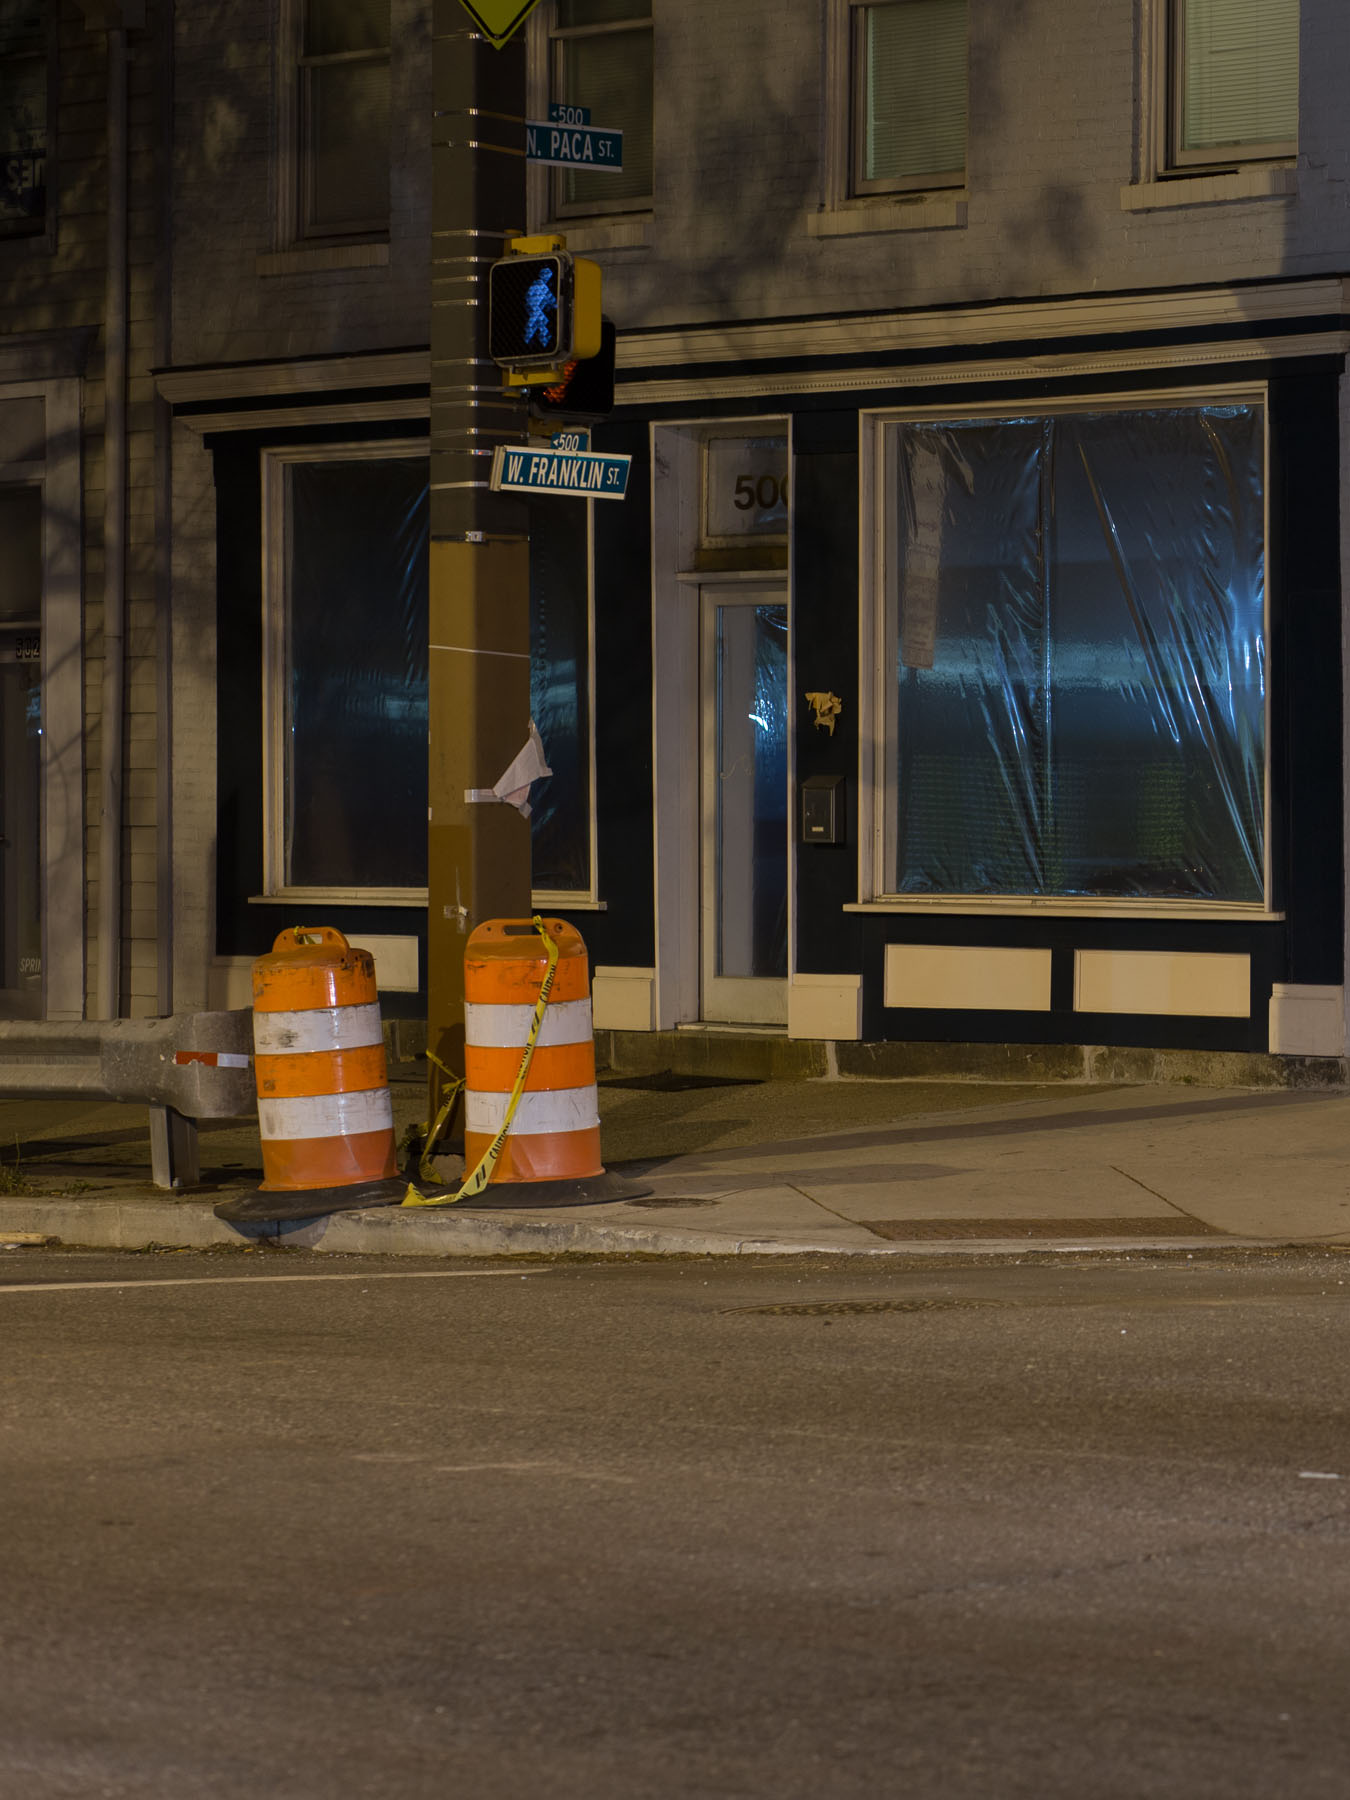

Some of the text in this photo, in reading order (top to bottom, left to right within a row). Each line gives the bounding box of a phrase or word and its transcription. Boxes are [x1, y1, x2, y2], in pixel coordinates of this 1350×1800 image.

[558, 106, 584, 126] 500
[526, 126, 615, 161] N. PACA ST.
[557, 434, 580, 451] 500
[507, 454, 620, 489] W. FRANKLIN ST.
